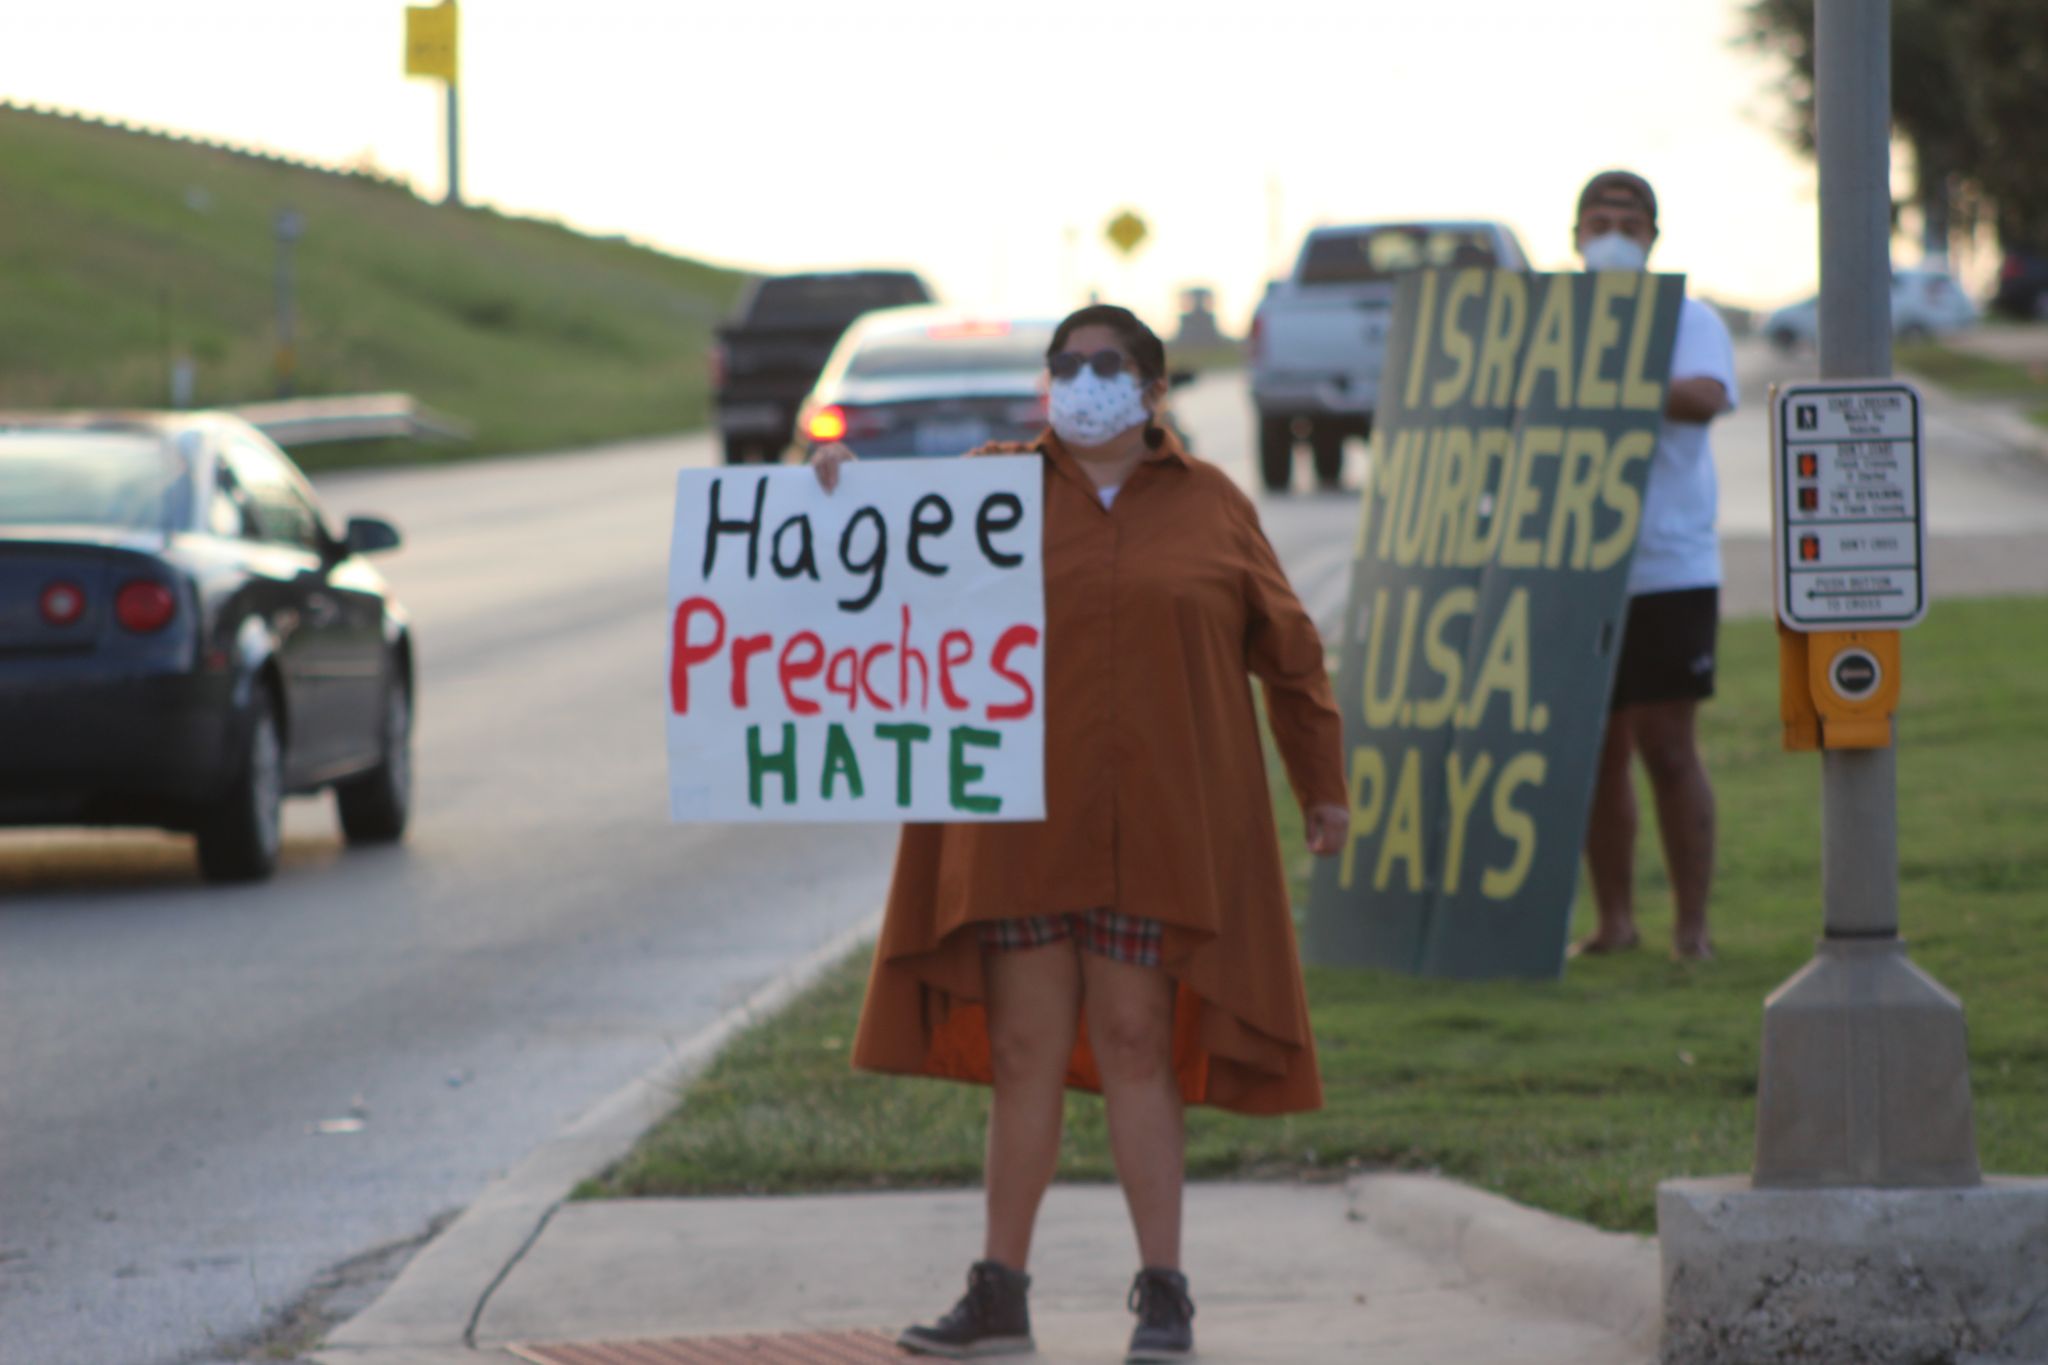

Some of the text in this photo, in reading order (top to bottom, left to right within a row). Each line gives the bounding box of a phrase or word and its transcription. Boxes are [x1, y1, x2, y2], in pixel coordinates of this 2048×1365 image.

[1404, 268, 1662, 410] ISRAEL
[702, 475, 1024, 613] Hagee
[1354, 426, 1656, 571] MURDERS
[669, 596, 1039, 721] Preaches
[1363, 587, 1549, 732] U.S.A.
[746, 722, 1003, 813] HATE
[1338, 747, 1547, 899] PAYS
